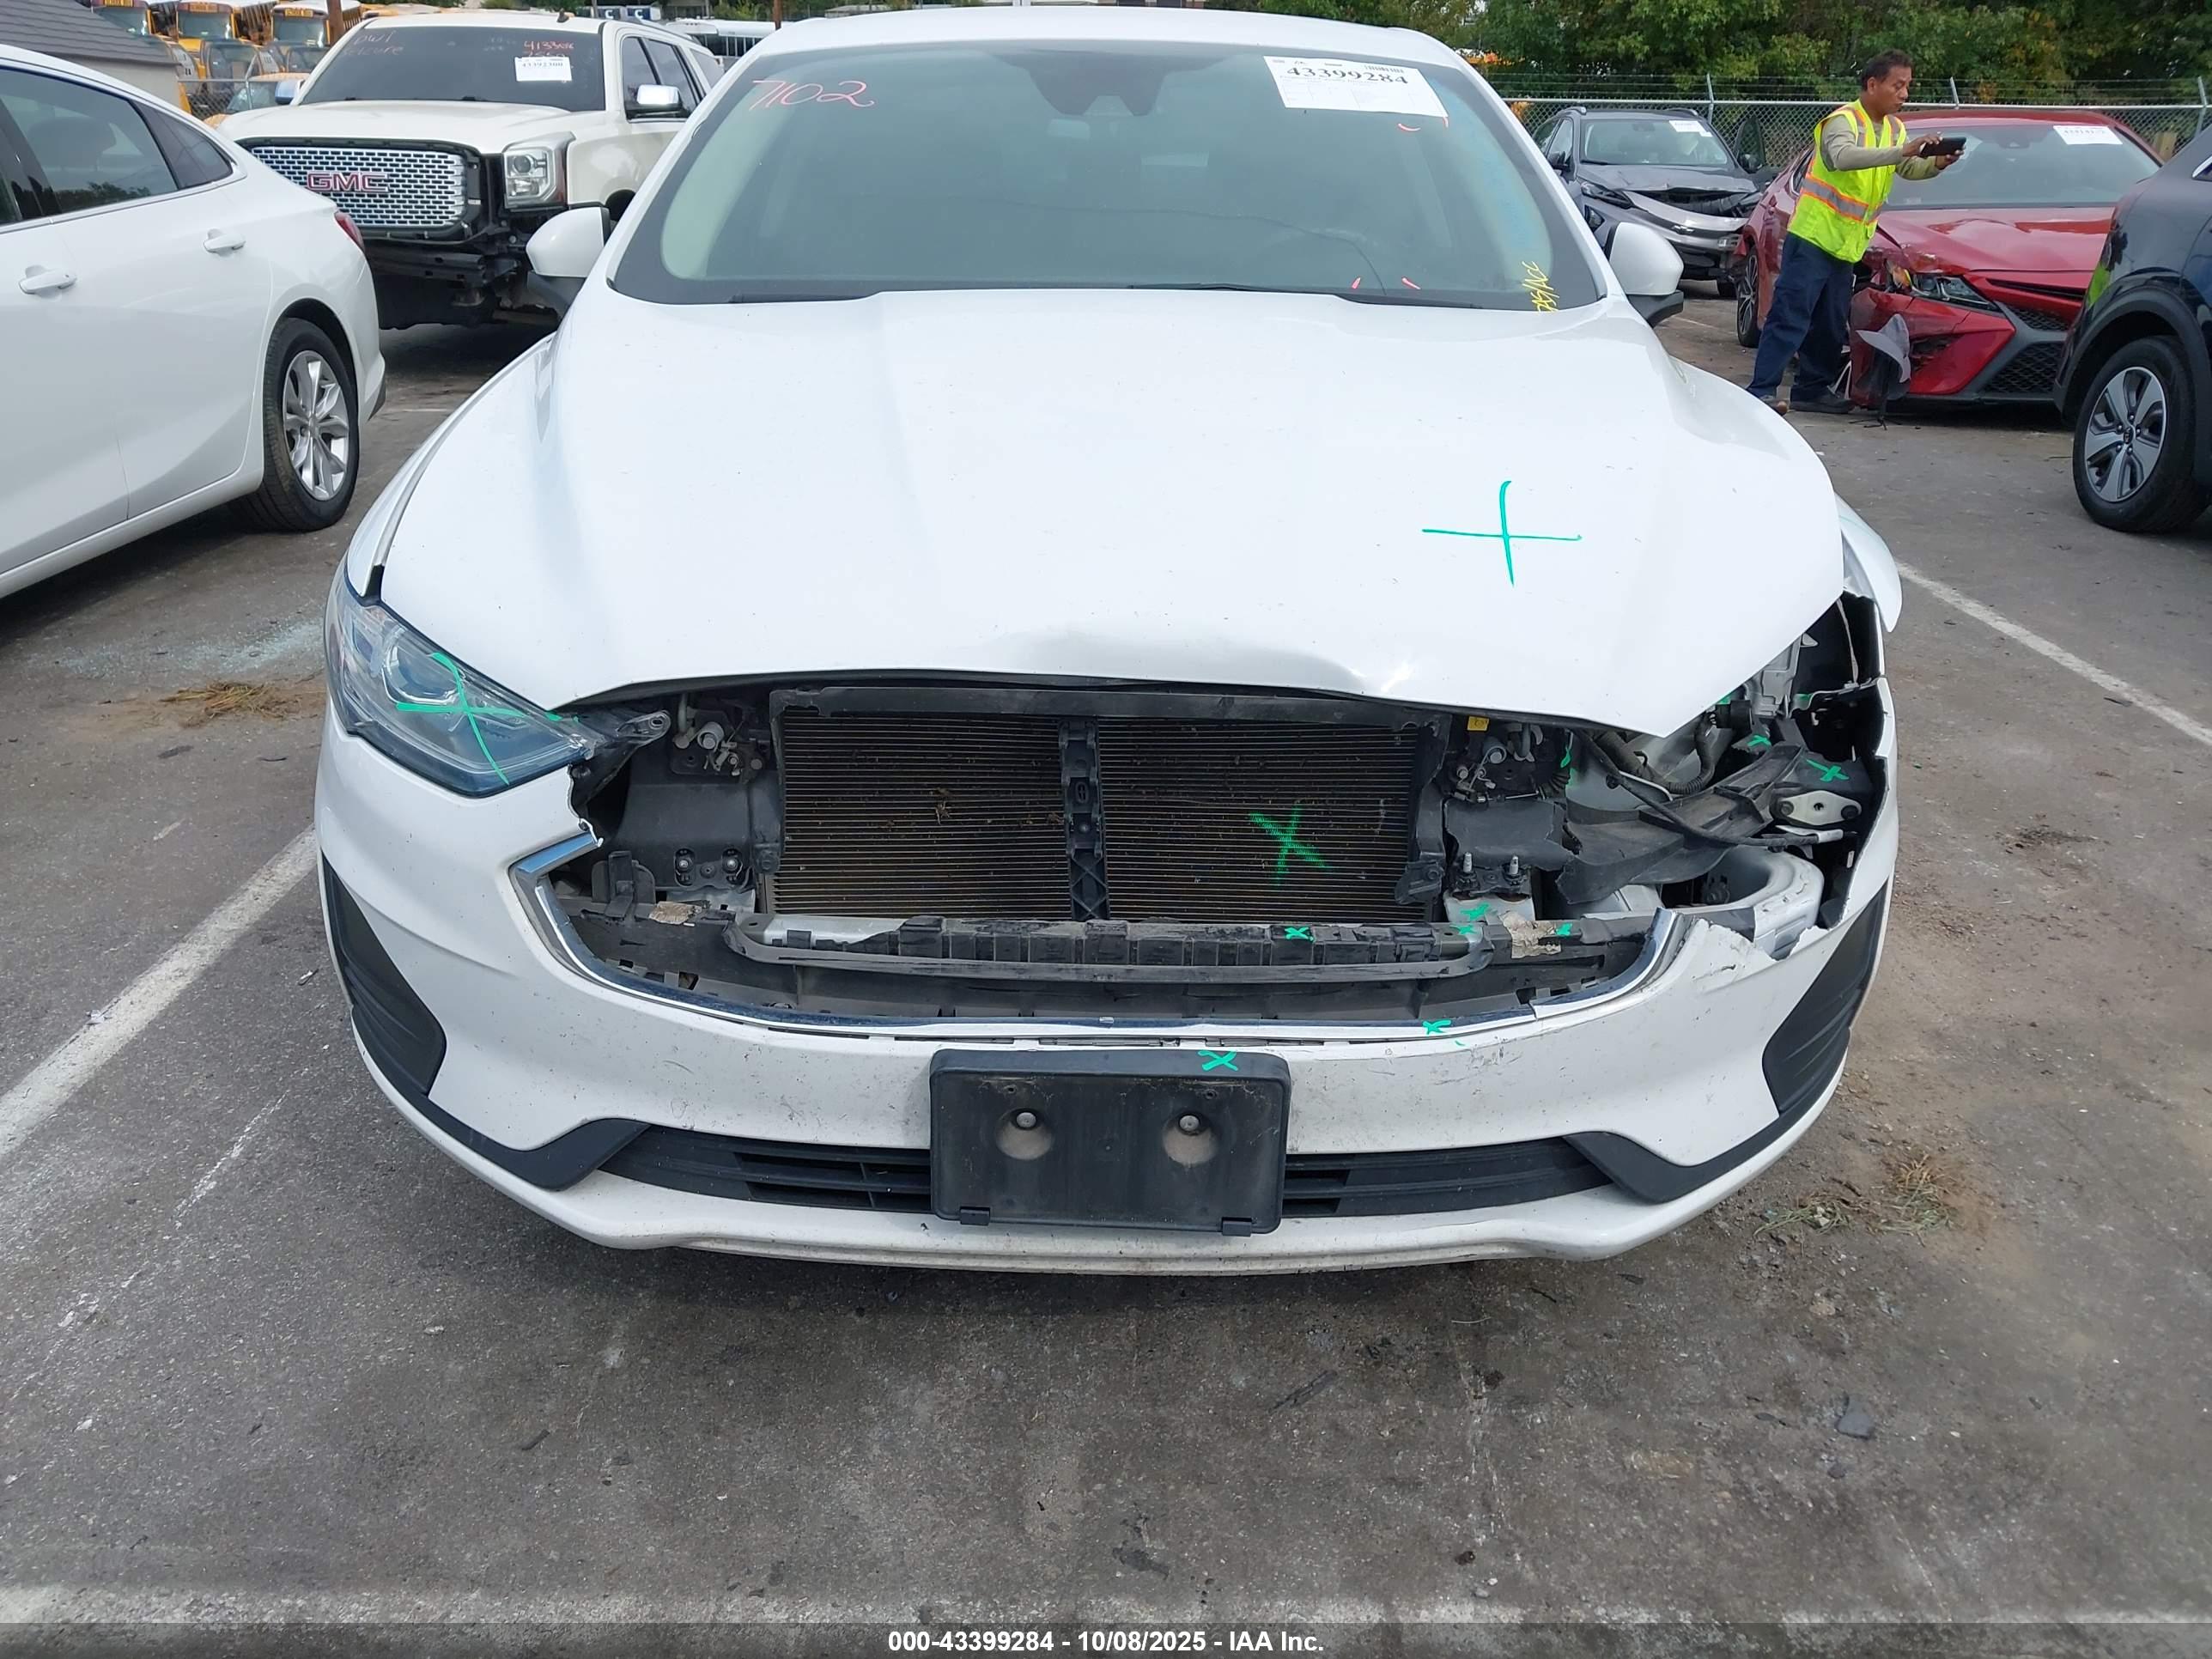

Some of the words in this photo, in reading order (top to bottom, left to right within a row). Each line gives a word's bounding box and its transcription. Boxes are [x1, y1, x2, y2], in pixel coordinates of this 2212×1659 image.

[1286, 66, 1409, 85] 43399284
[748, 80, 875, 112] 7102
[307, 172, 390, 193] GMC
